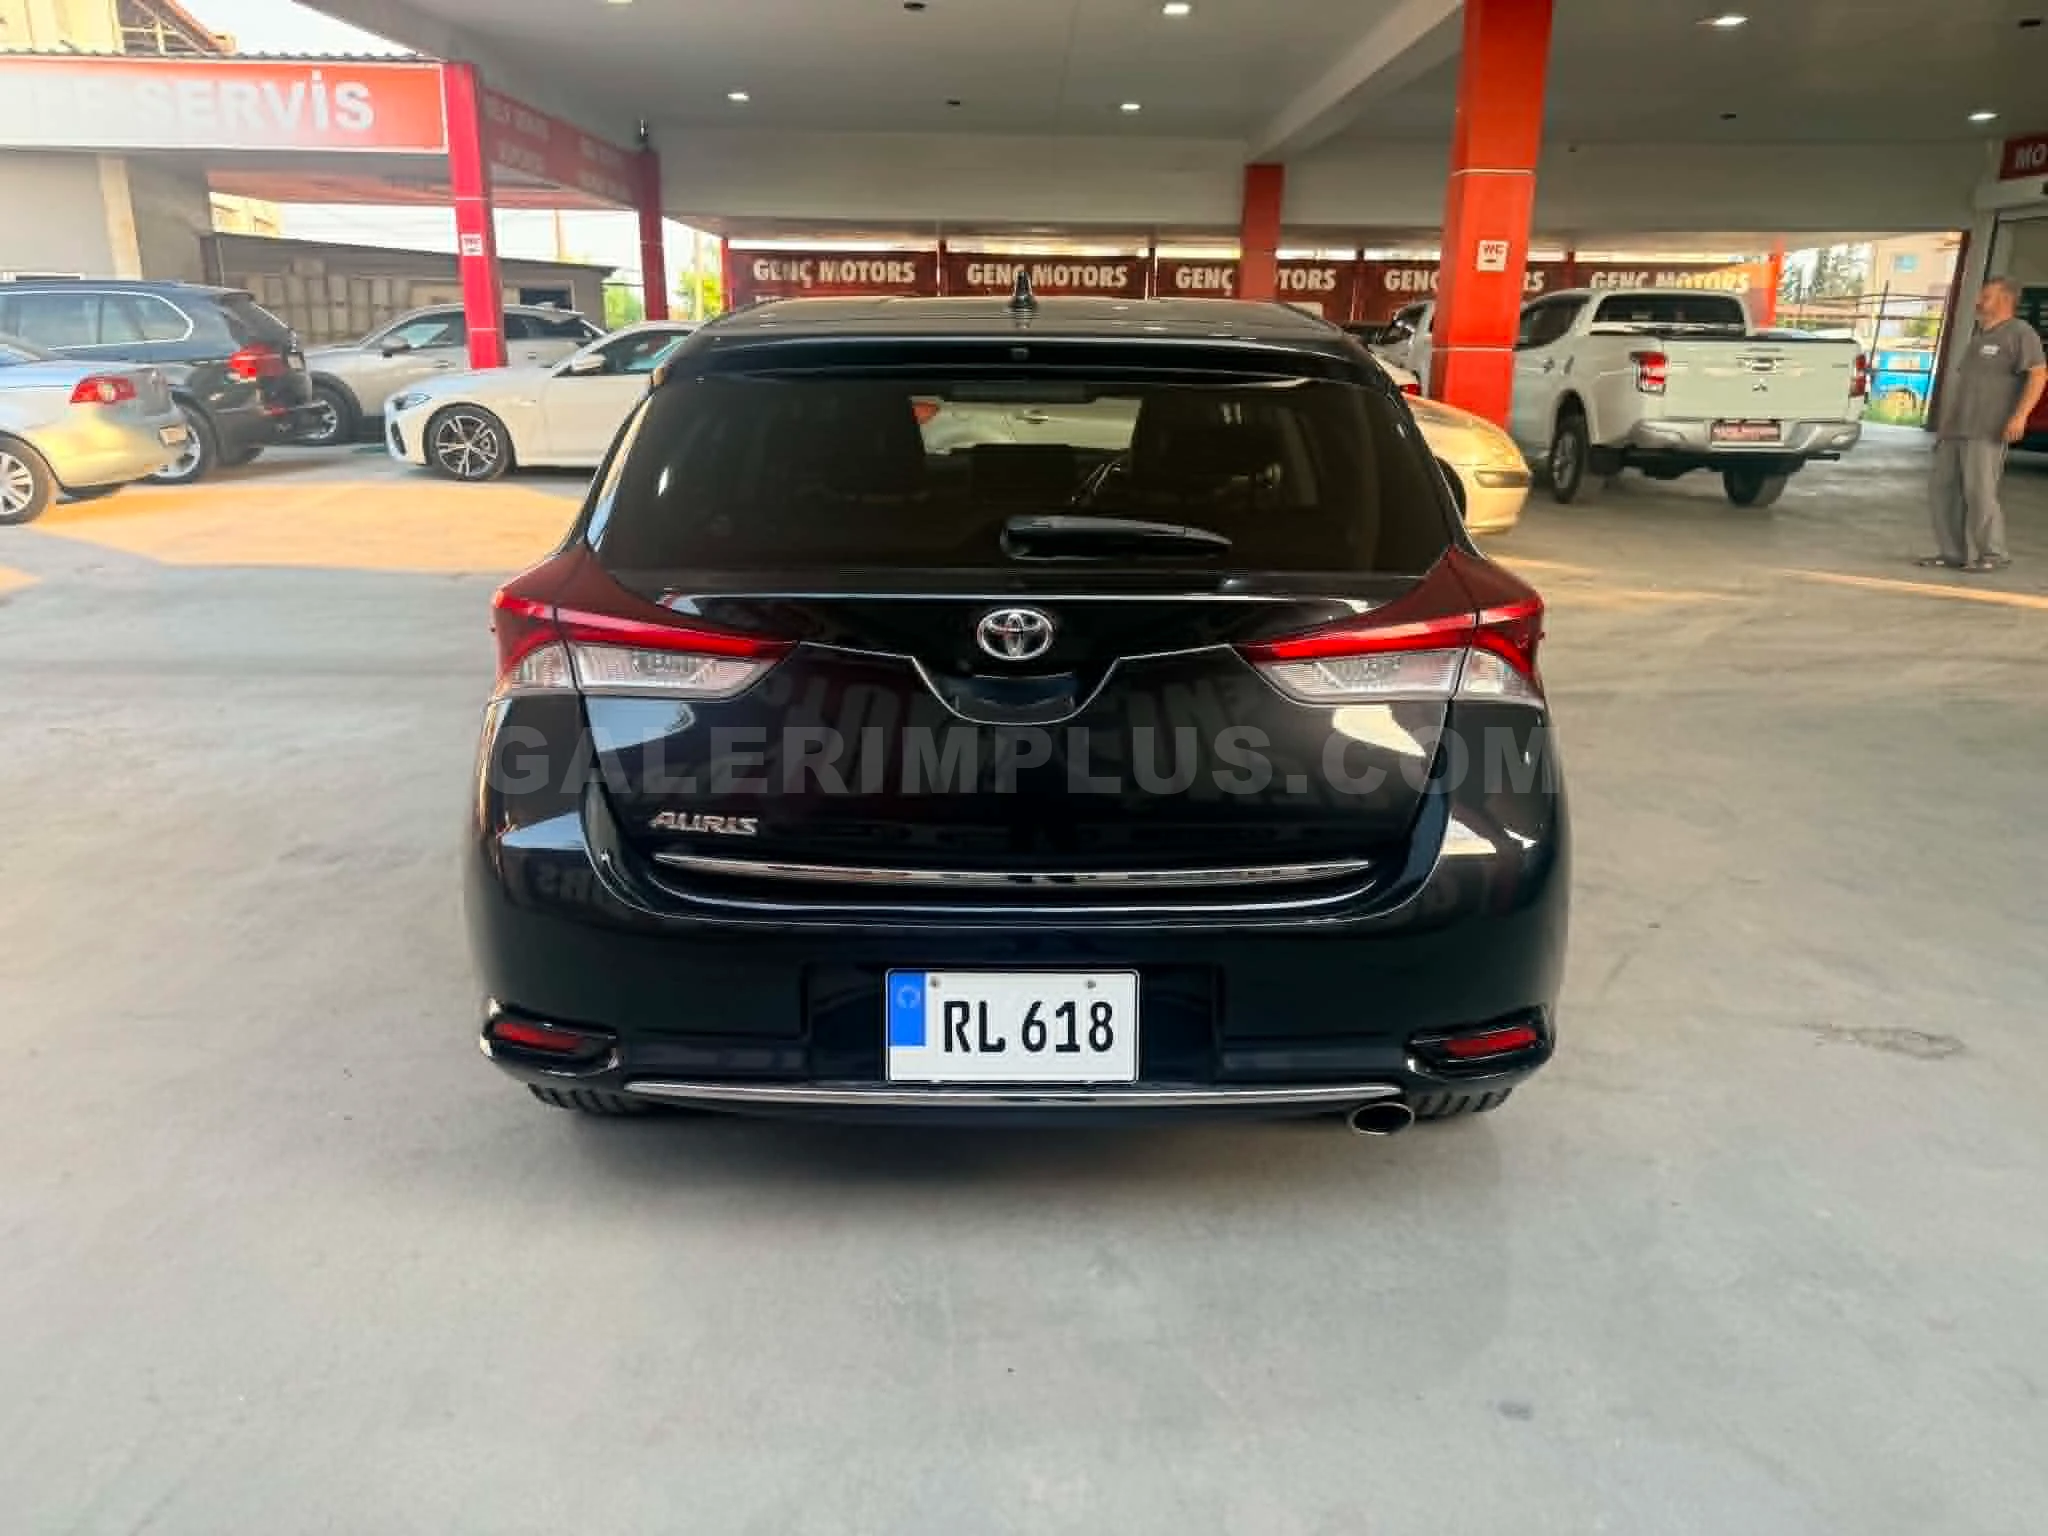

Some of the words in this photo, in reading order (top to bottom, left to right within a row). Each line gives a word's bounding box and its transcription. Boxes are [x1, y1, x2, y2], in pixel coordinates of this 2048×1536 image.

[753, 258, 814, 288] GENÇ
[817, 260, 917, 285] MOTORS
[1031, 263, 1129, 288] MOTORS
[1175, 266, 1235, 297] GENÇ
[1274, 268, 1337, 290] TORS
[649, 811, 760, 836] AURIS
[943, 1000, 1006, 1053] RL
[1021, 1000, 1115, 1053] 618
